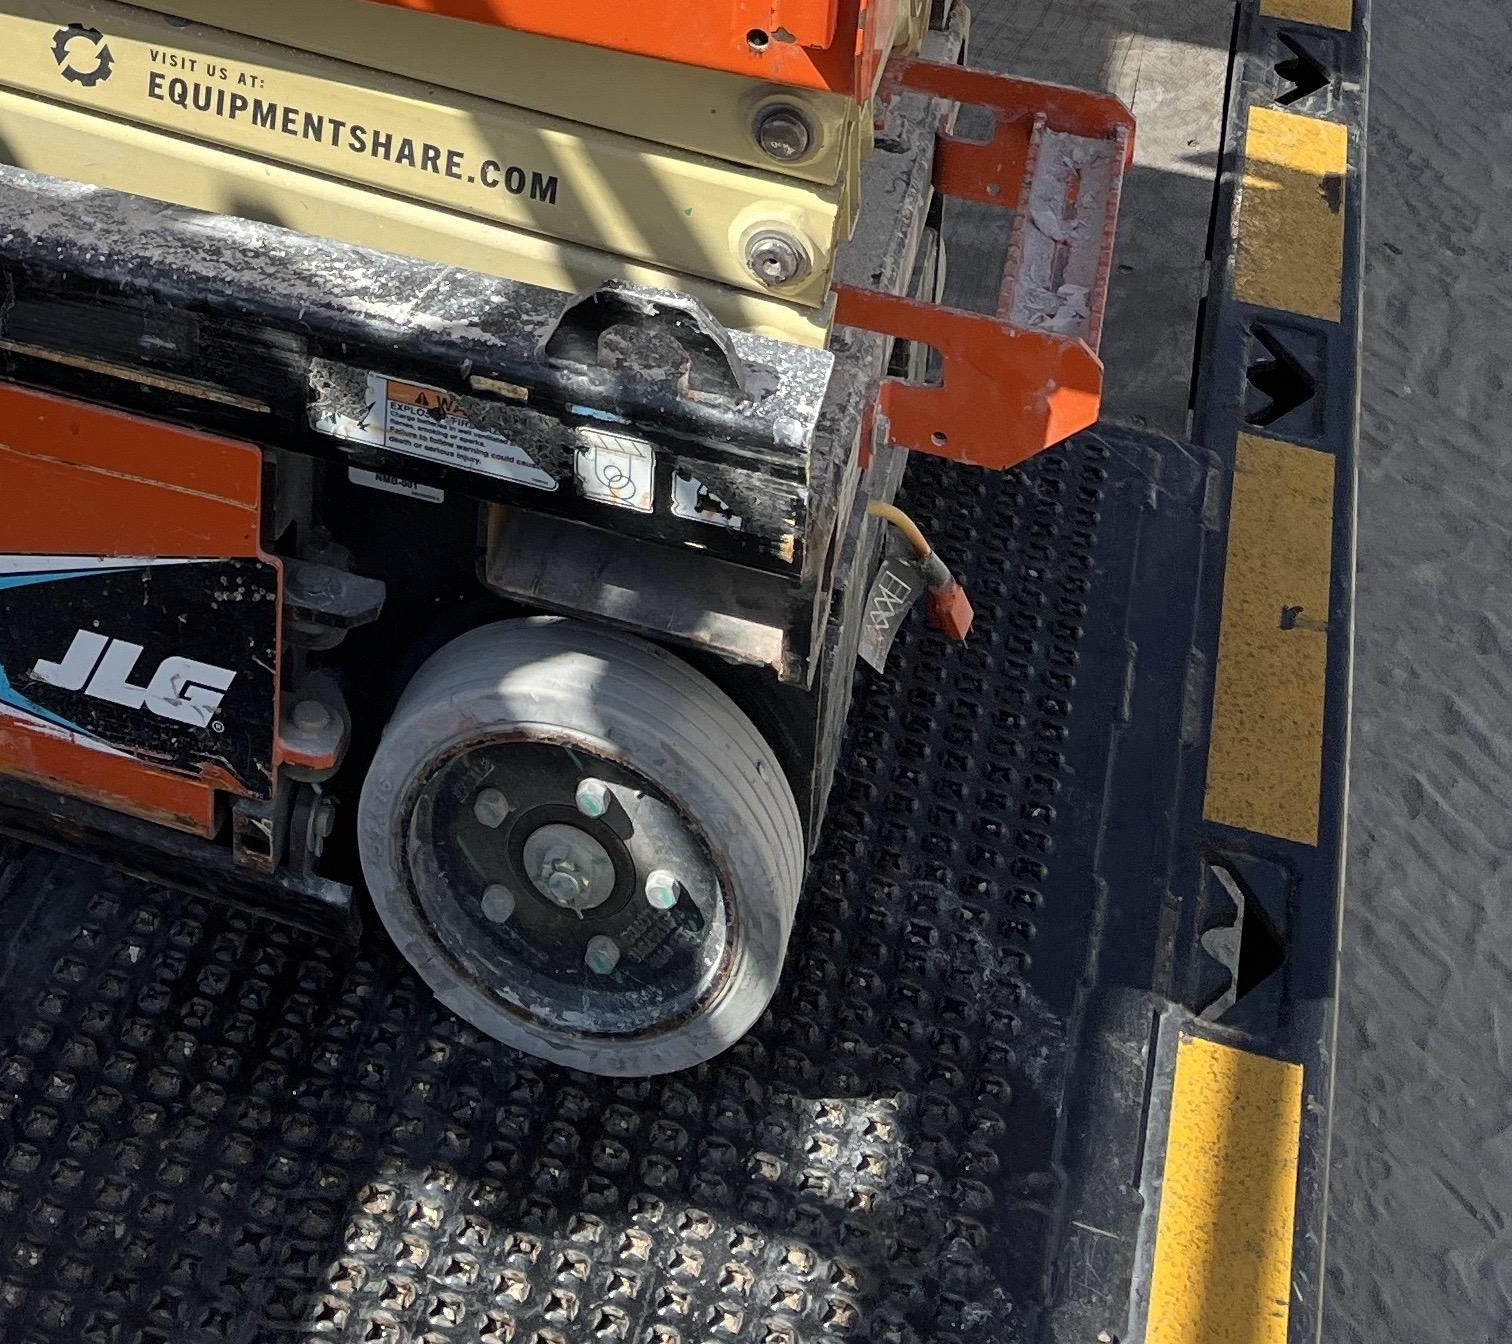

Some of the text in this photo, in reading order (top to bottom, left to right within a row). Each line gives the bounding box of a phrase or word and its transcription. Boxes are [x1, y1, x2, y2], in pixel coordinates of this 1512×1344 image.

[148, 49, 267, 90] VISIT US AT:
[147, 70, 560, 207] EQUIPMENTSHARE.COM
[389, 426, 417, 439] Failure
[418, 432, 428, 441] to
[429, 435, 454, 449] follow
[456, 443, 489, 458] warning
[490, 452, 515, 463] could
[417, 425, 449, 439] smoking
[424, 444, 455, 458] serious
[30, 628, 238, 729] JLG
